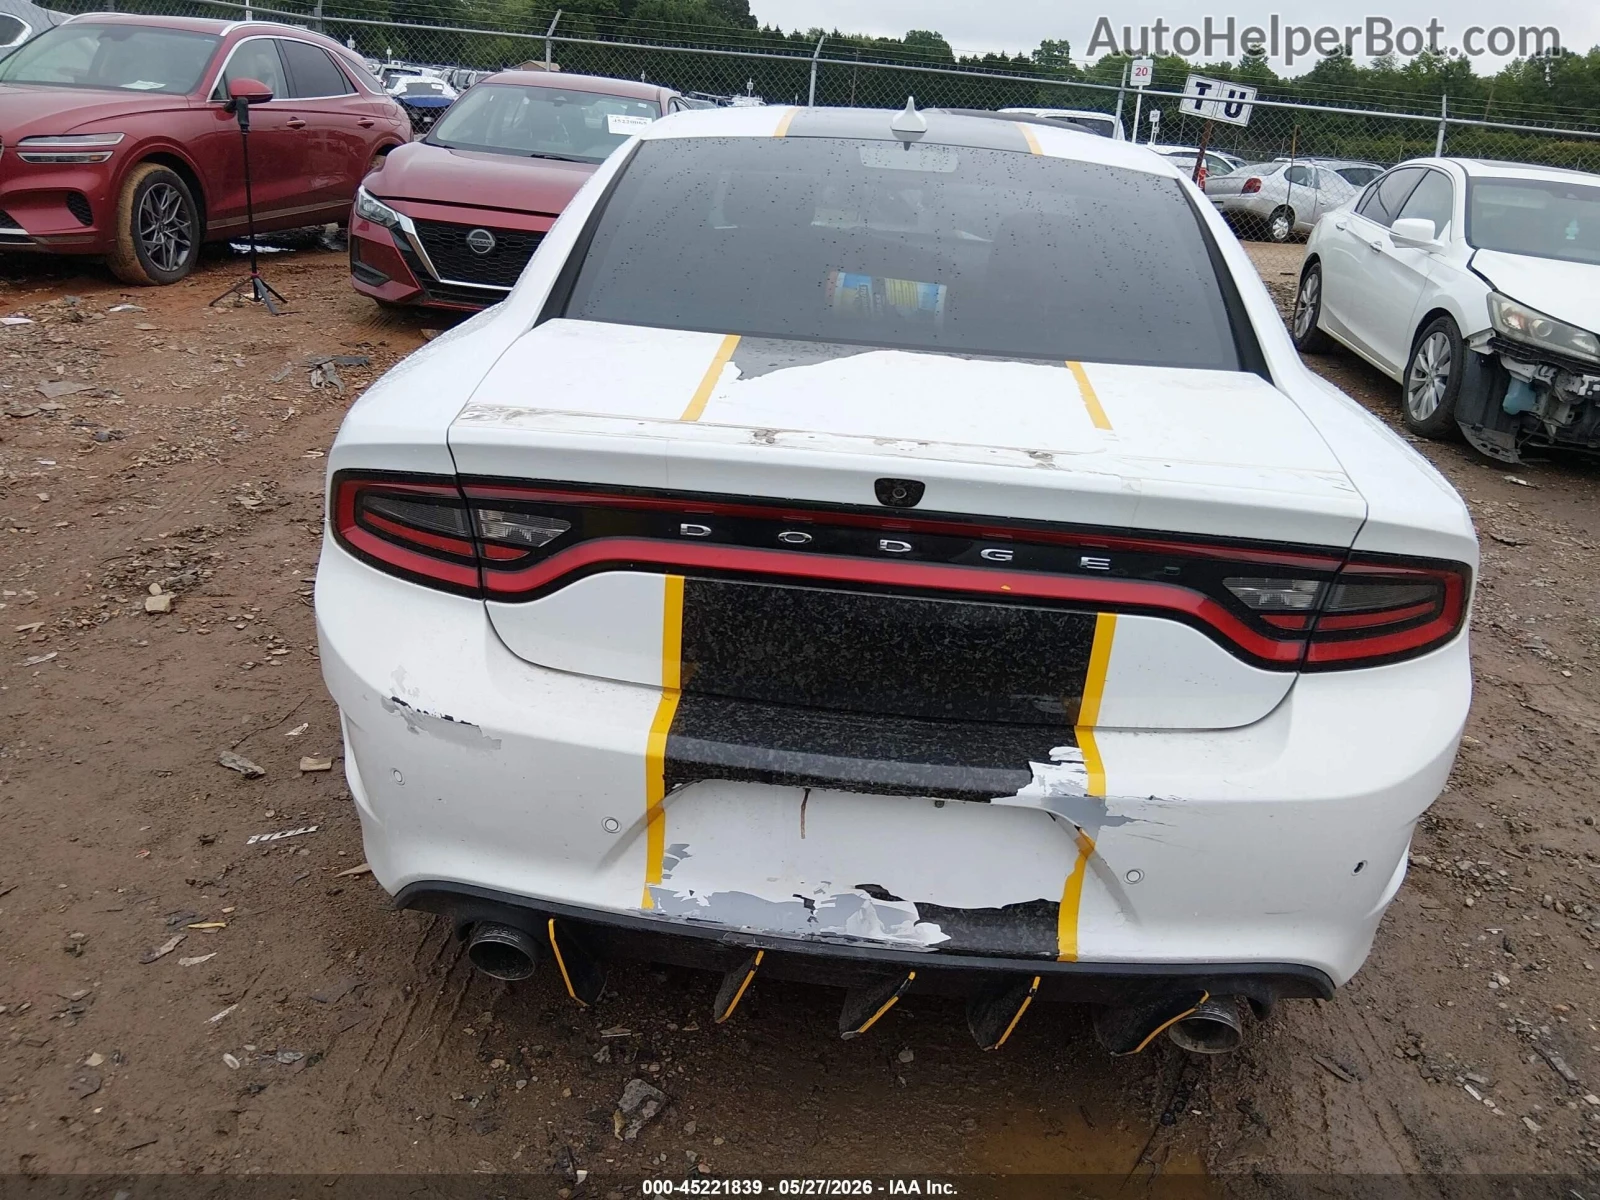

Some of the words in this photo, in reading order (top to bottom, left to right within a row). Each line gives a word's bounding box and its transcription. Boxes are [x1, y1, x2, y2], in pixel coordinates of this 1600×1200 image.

[1135, 67, 1148, 77] 20
[1195, 81, 1213, 111] T
[1224, 89, 1247, 119] U
[680, 522, 1111, 571] DODGE
